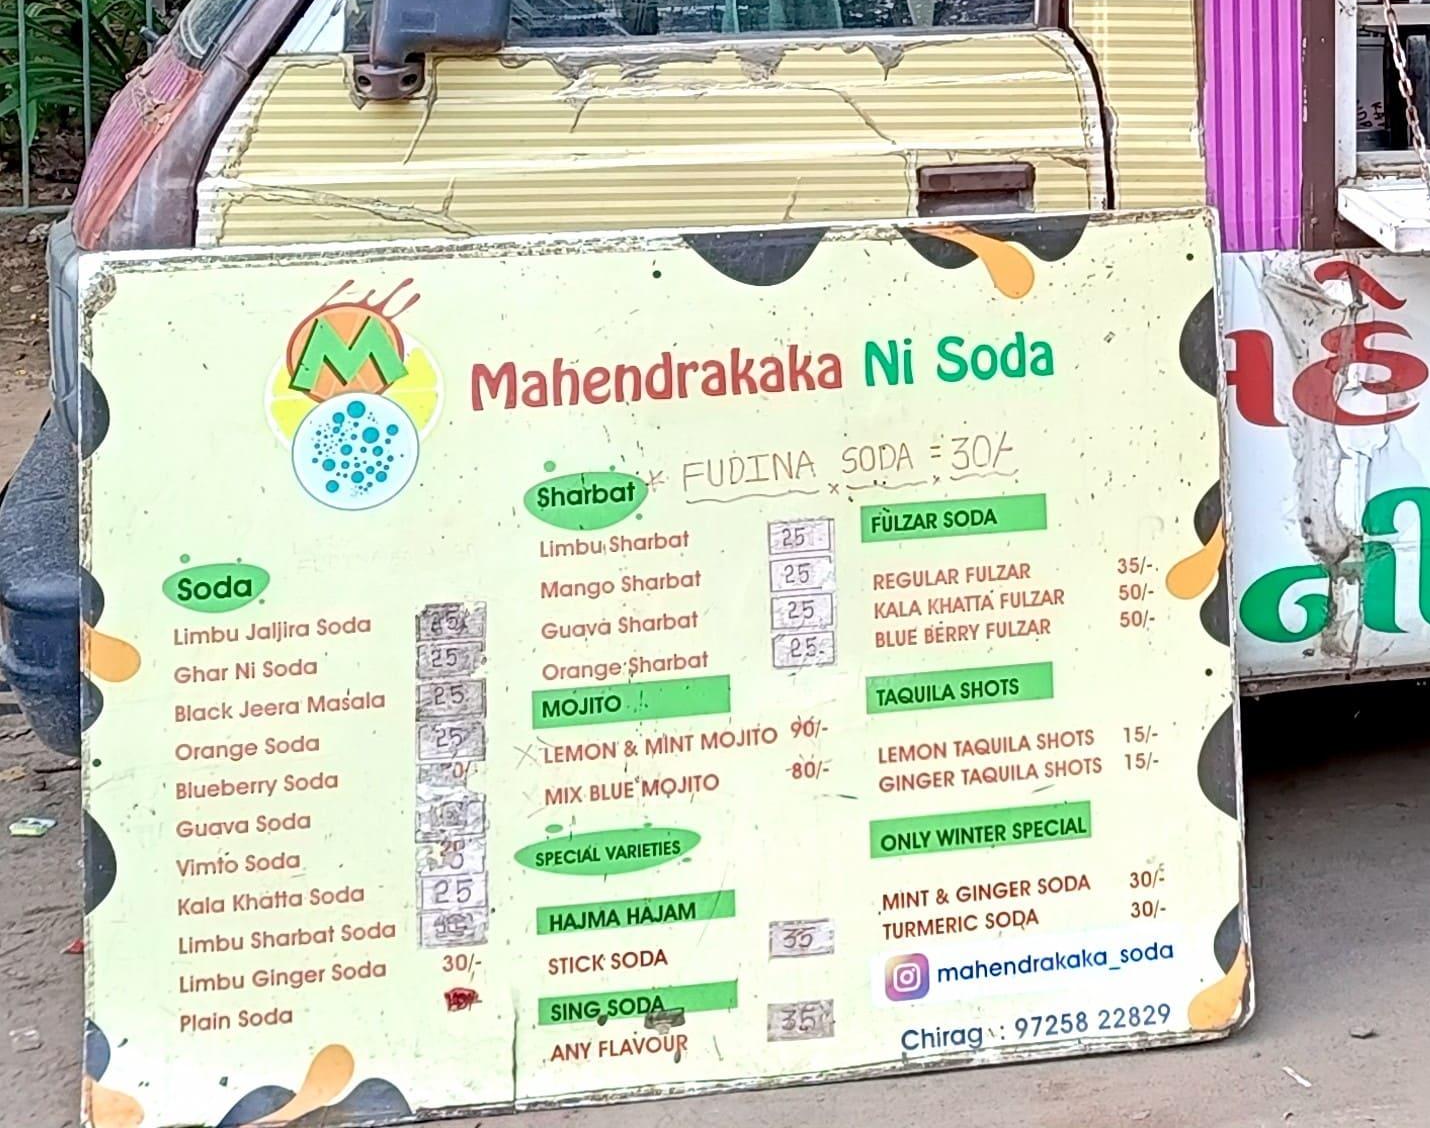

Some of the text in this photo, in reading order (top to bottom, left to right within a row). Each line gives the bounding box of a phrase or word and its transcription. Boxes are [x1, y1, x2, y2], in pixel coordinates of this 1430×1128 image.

[471, 331, 1055, 411] Mahendrakaka Ni Soda
[682, 449, 816, 492] FUDINA
[842, 442, 914, 474] SODA
[536, 480, 636, 507] Sharbat
[872, 508, 998, 534] FULZAR SODA
[539, 532, 689, 558] Limbu Sharbat
[782, 527, 805, 547] 25
[784, 563, 810, 583] 25
[873, 563, 1031, 591] REGULAR FULZAR
[1117, 556, 1154, 575] 35/-
[176, 576, 253, 601] Soda
[540, 570, 701, 600] Mango Sharbat
[1118, 583, 1155, 601] 50/-
[788, 600, 814, 619] 25
[873, 588, 1065, 619] KALA KHATTA FULZAR
[173, 617, 372, 646] Limbu Jaljira Soda
[541, 610, 698, 640] Guava Sharbat
[874, 618, 1052, 648] BLUE BERRY FULZAR
[1119, 610, 1156, 628] 50/-
[431, 648, 458, 667] 25
[542, 651, 708, 681] Orange Sharbat
[174, 658, 318, 686] Ghar Ni Soda
[434, 685, 464, 705] 25
[542, 694, 622, 718] MOJITO
[876, 678, 1020, 706] TAQUILA SHOTS
[174, 691, 385, 723] Black Jeera Masala
[436, 728, 462, 748] 25
[789, 720, 829, 739] 90/-
[1122, 726, 1159, 744] 15/-
[175, 735, 320, 763] Orange Soda
[543, 727, 777, 765] LEMON & MINT MOJITO
[878, 729, 1095, 764] LEMON TAQUILA SHOTS
[879, 757, 1103, 794] GINGER TAQUILA SHOTS
[1124, 753, 1160, 770] 15/-
[175, 772, 338, 802] Blueberry Soda
[545, 773, 721, 806] MIX BLUE MOJITO
[176, 813, 311, 839] Guava Soda
[880, 816, 1088, 853] ONLY WINTER SPECIAL
[176, 852, 300, 877] Vimto Soda
[535, 839, 681, 868] SPECIAL VARIETIES
[434, 879, 473, 903] 25
[882, 874, 1090, 911] MINT & GINGER SODA
[1129, 870, 1165, 889] 30/-
[177, 885, 365, 916] Kala Khatta Soda
[1130, 900, 1167, 918] 30/-
[548, 903, 696, 933] HAJMA HAJAM
[882, 908, 1039, 940] TURMERIC SODA
[178, 921, 397, 956] Limbu Sharbat Soda
[783, 927, 816, 948] 35
[443, 954, 482, 973] 30/-
[548, 950, 668, 975] STICK SODA
[937, 941, 1175, 983] mahendrakaka_soda
[179, 960, 387, 995] Limbu Ginger Soda
[180, 1007, 293, 1033] Plain Soda
[550, 994, 666, 1020] SING SODA
[901, 1024, 983, 1055] Chirag
[1014, 1011, 1088, 1039] 97258
[1097, 1005, 1171, 1031] 22829
[550, 1033, 690, 1063] ANY FLAVOUR
